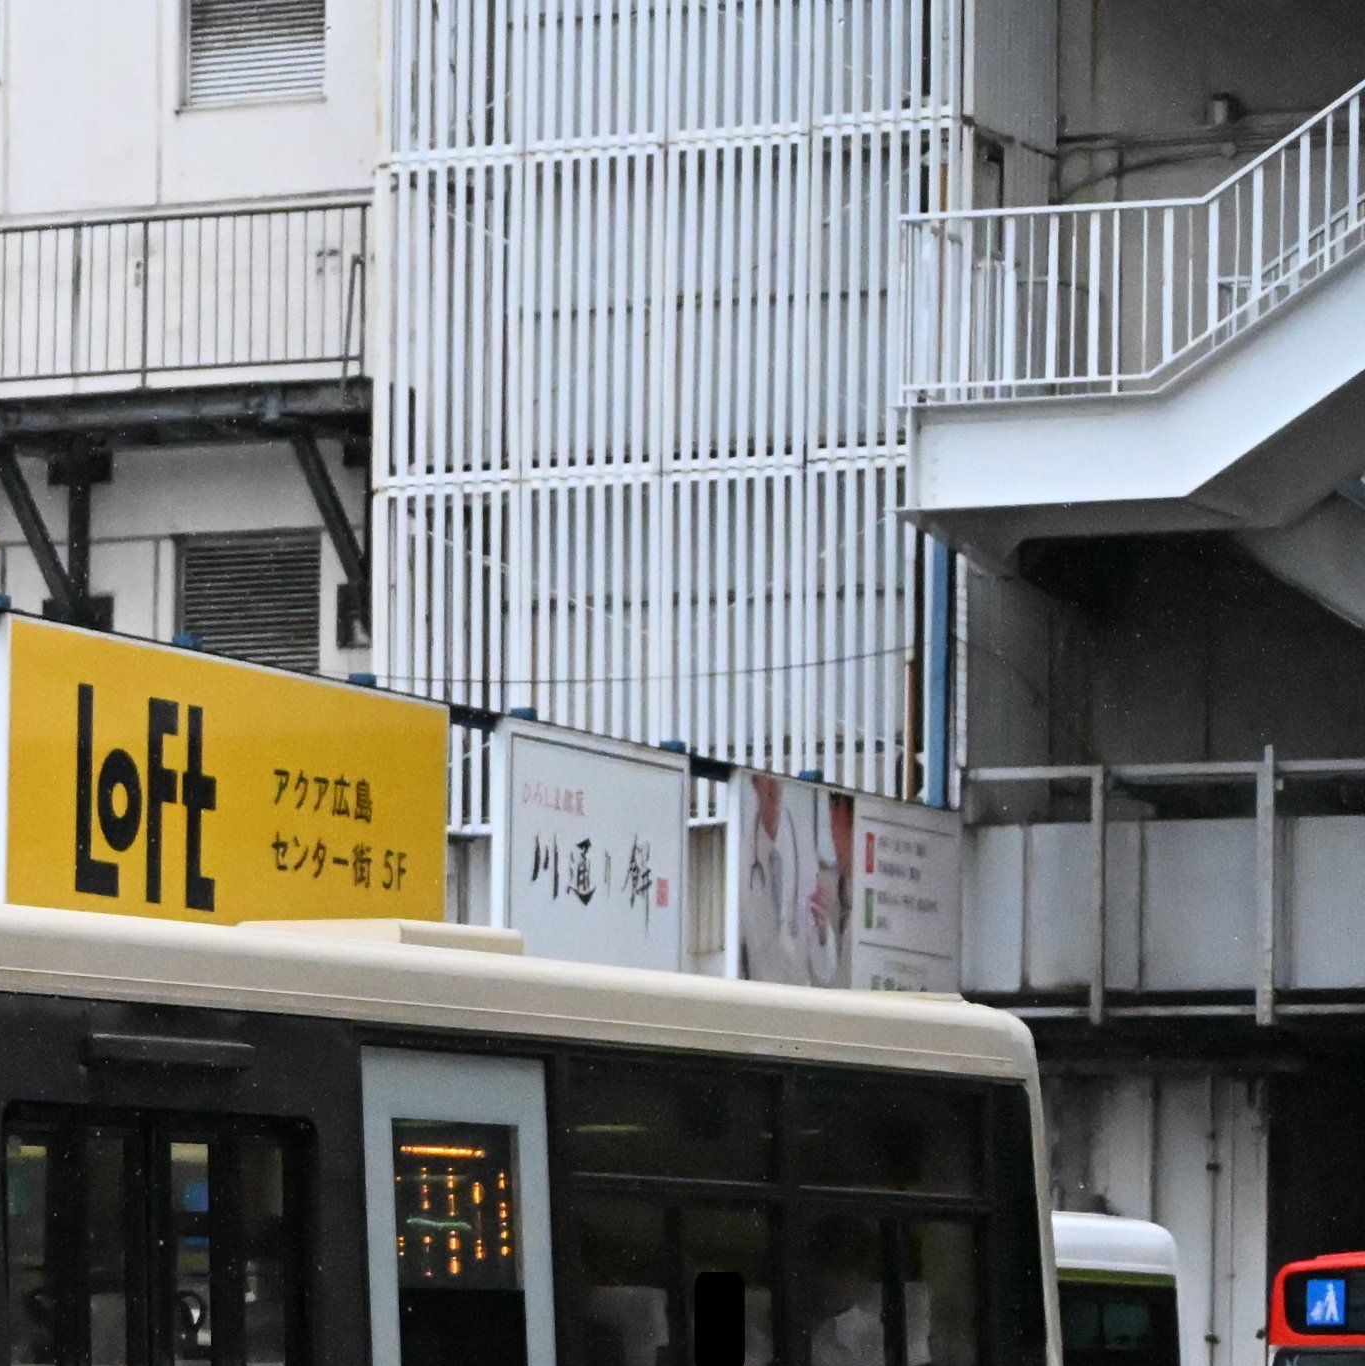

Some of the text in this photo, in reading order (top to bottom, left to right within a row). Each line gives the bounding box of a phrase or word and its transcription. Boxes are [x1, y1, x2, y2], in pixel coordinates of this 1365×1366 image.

[273, 768, 374, 824] アクア広島
[271, 831, 408, 891] センター街 5F
